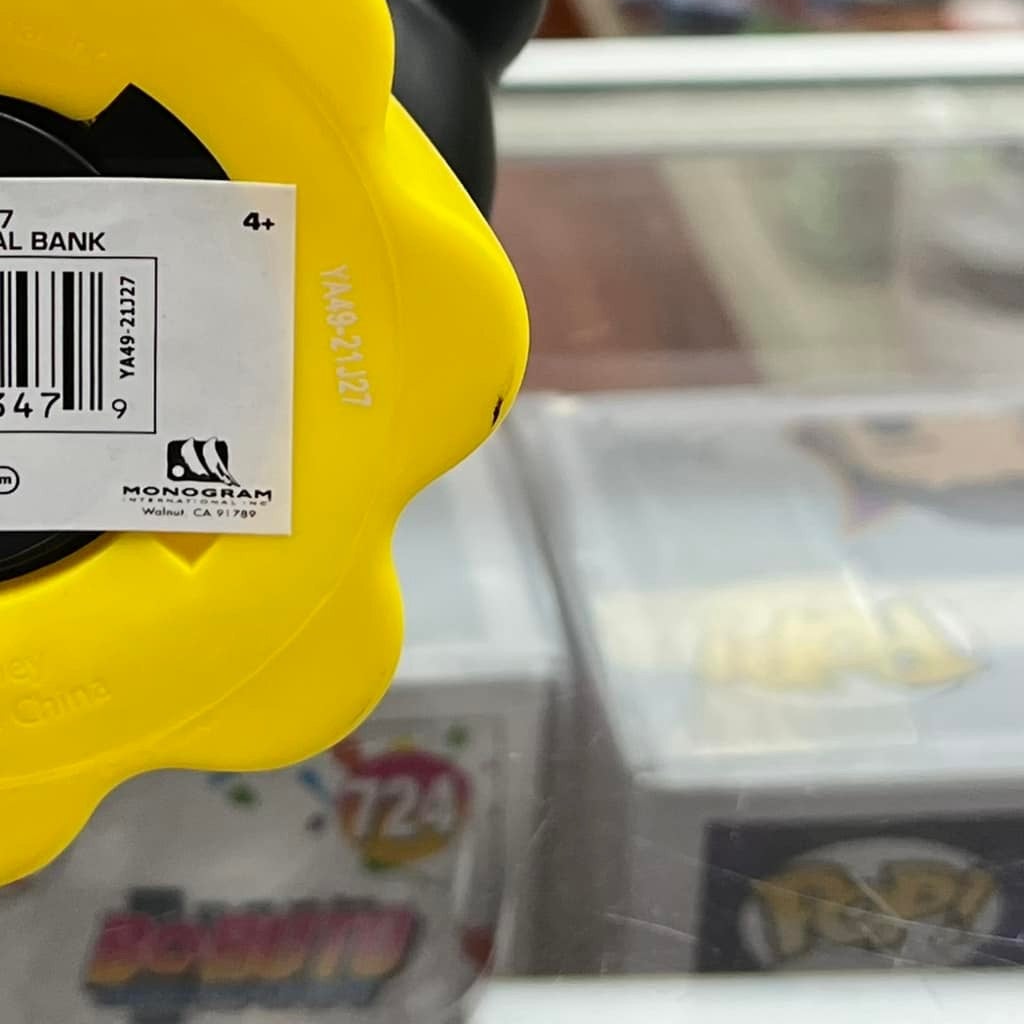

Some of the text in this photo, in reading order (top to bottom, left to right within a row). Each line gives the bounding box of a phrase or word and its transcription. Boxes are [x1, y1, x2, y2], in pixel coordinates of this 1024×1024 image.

[242, 211, 276, 231] 4+
[30, 231, 107, 252] BANK
[119, 275, 136, 380] YA49-21J27
[319, 264, 374, 408] YA49-21J27
[122, 485, 273, 502] MONOGRAM
[192, 508, 212, 518] CA
[216, 509, 257, 519] 91789
[12, 678, 113, 725] China
[342, 774, 457, 839] 724
